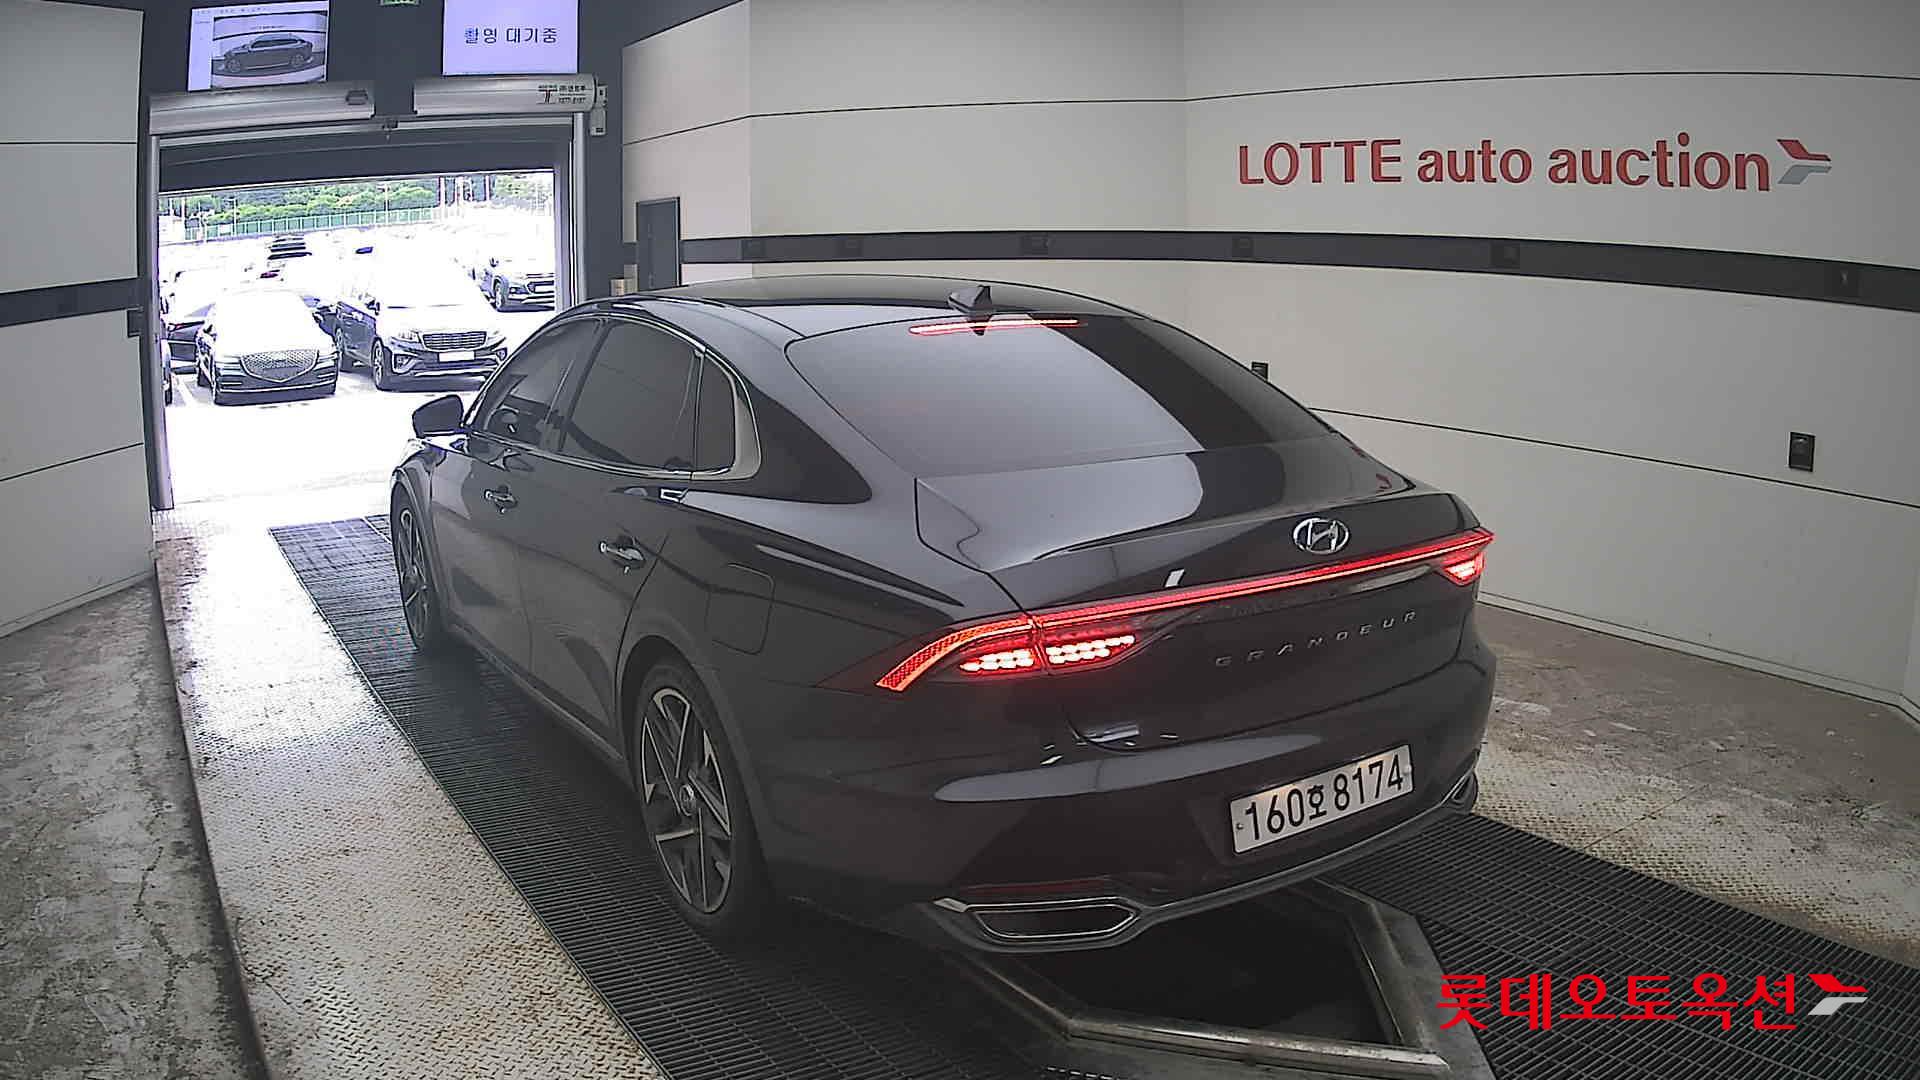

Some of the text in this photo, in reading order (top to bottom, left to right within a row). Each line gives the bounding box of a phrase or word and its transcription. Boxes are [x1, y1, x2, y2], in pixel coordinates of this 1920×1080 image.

[506, 27, 558, 44] 대기중
[1239, 131, 1770, 191] LOTTE auto auction
[1215, 609, 1415, 666] GRANDEUR
